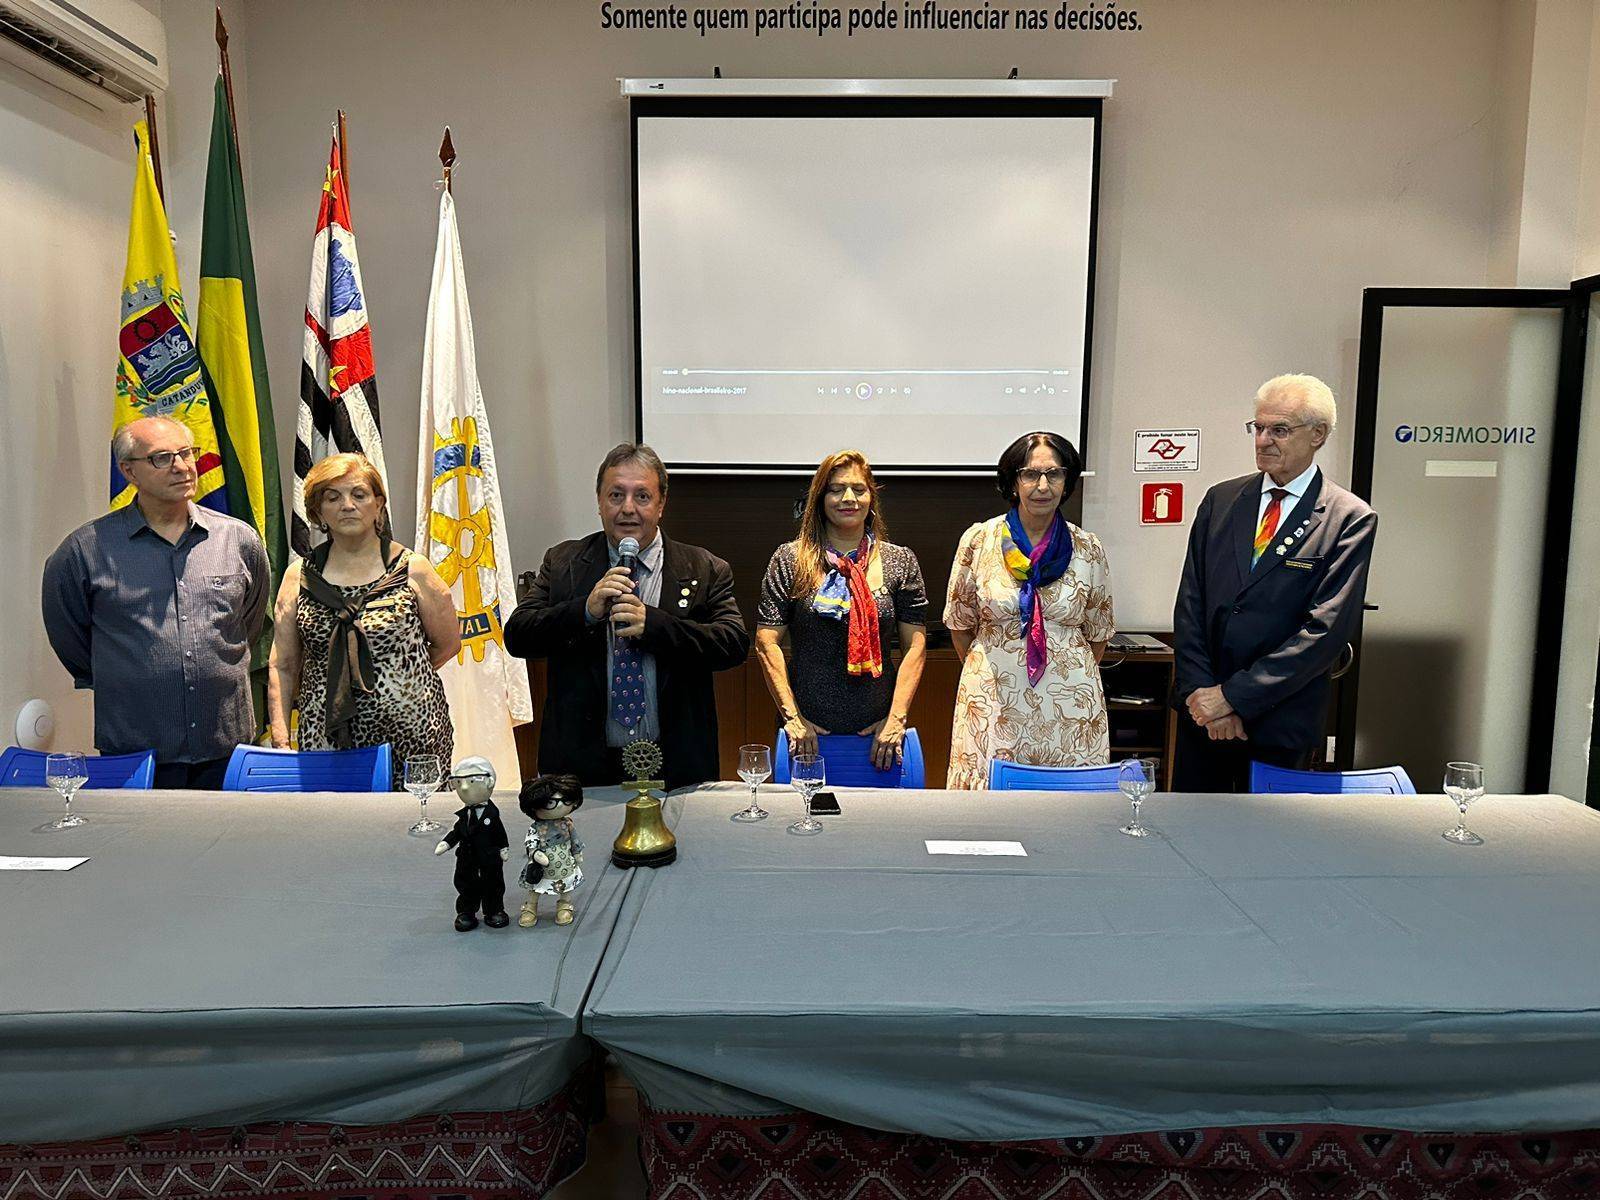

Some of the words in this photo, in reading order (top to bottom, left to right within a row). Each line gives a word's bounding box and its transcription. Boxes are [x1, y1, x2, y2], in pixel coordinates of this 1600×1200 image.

[601, 3, 687, 29] Somente
[693, 9, 748, 36] quem
[756, 1, 841, 36] participa
[848, 1, 897, 36] pode
[904, 1, 1010, 30] influenciar
[1015, 9, 1048, 30] nas
[1054, 1, 1143, 31] decisões.
